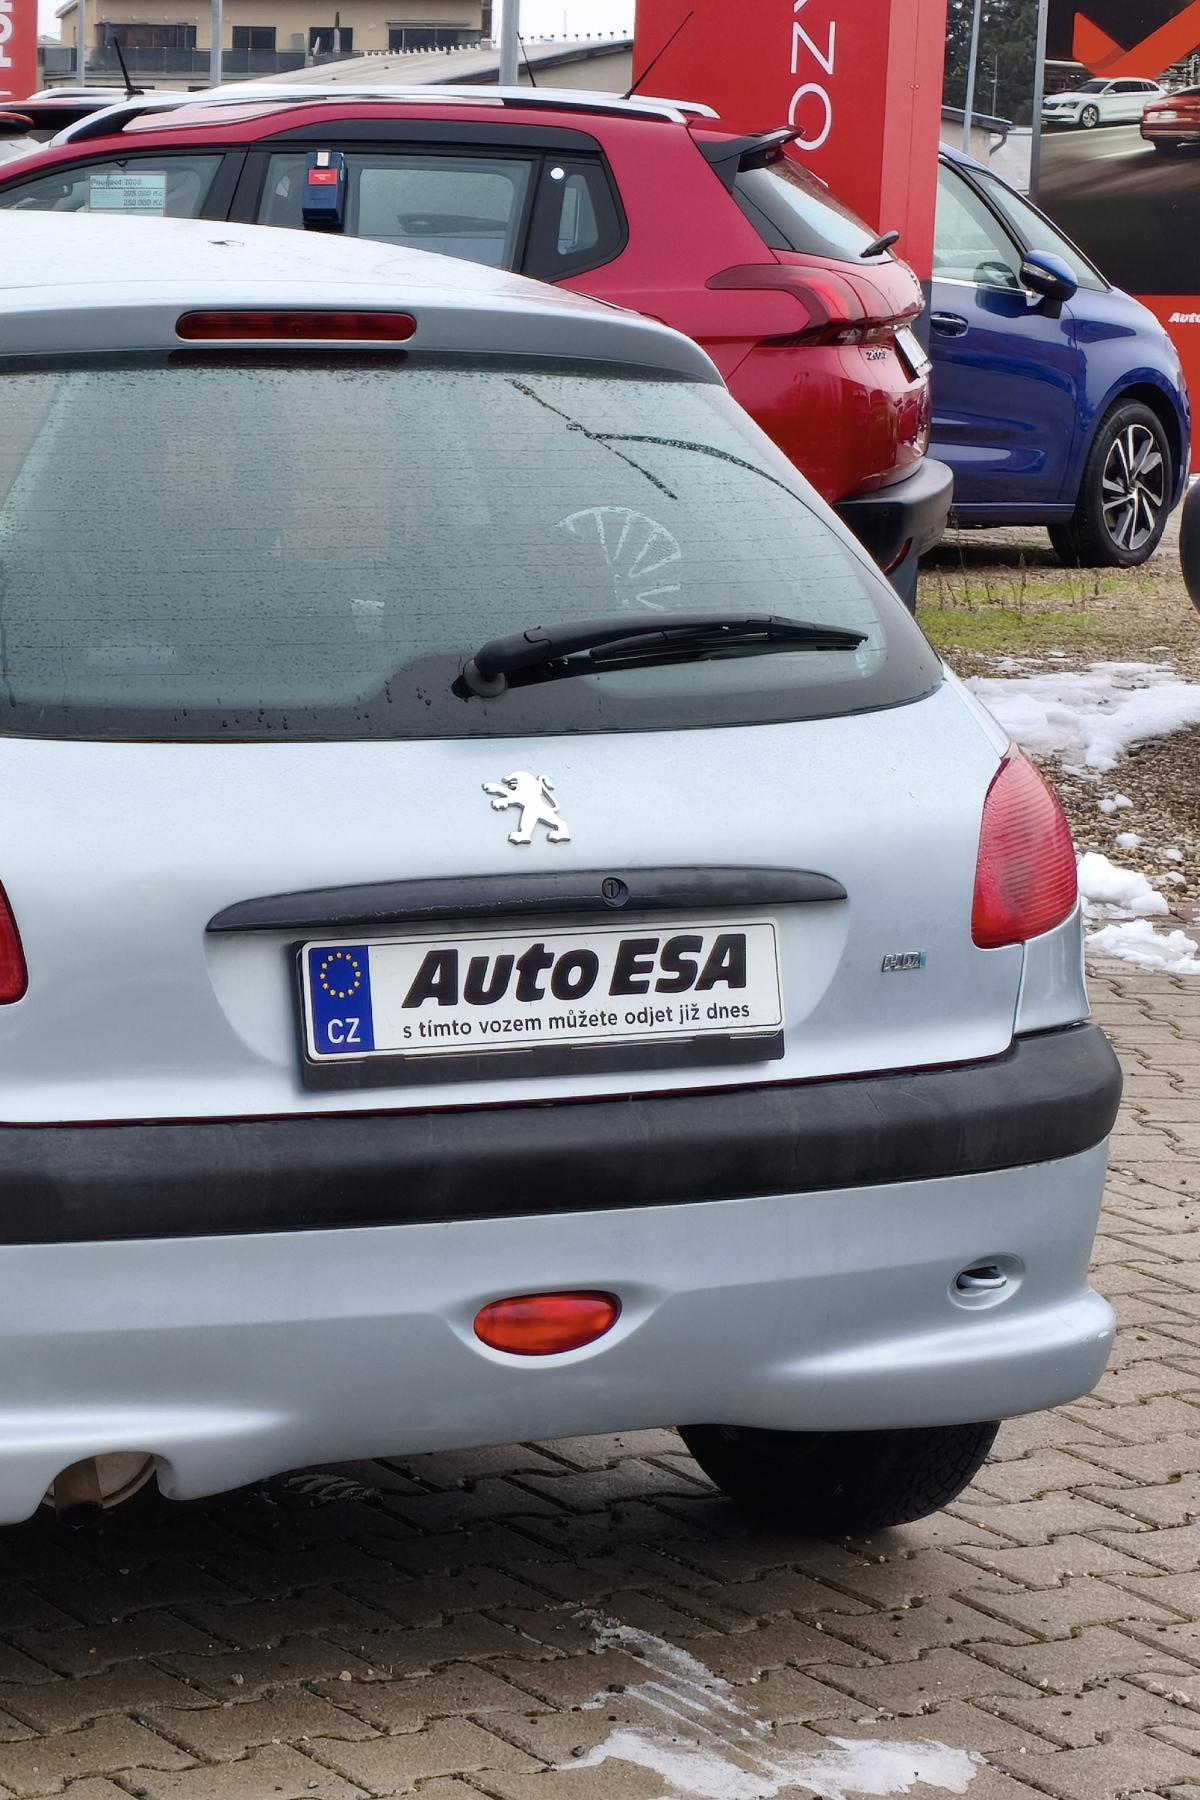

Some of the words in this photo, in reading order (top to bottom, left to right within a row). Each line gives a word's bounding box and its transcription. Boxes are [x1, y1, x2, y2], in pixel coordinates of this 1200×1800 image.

[401, 943, 600, 1008] Auto
[608, 933, 748, 997] ESA
[327, 1017, 361, 1044] CZ
[402, 1025, 413, 1039] s
[418, 1018, 472, 1038] tímto
[478, 1016, 542, 1034] vozem
[548, 1009, 619, 1030] můžete
[624, 1005, 674, 1027] odjet
[679, 1003, 700, 1025] již
[706, 1002, 751, 1021] dnes
